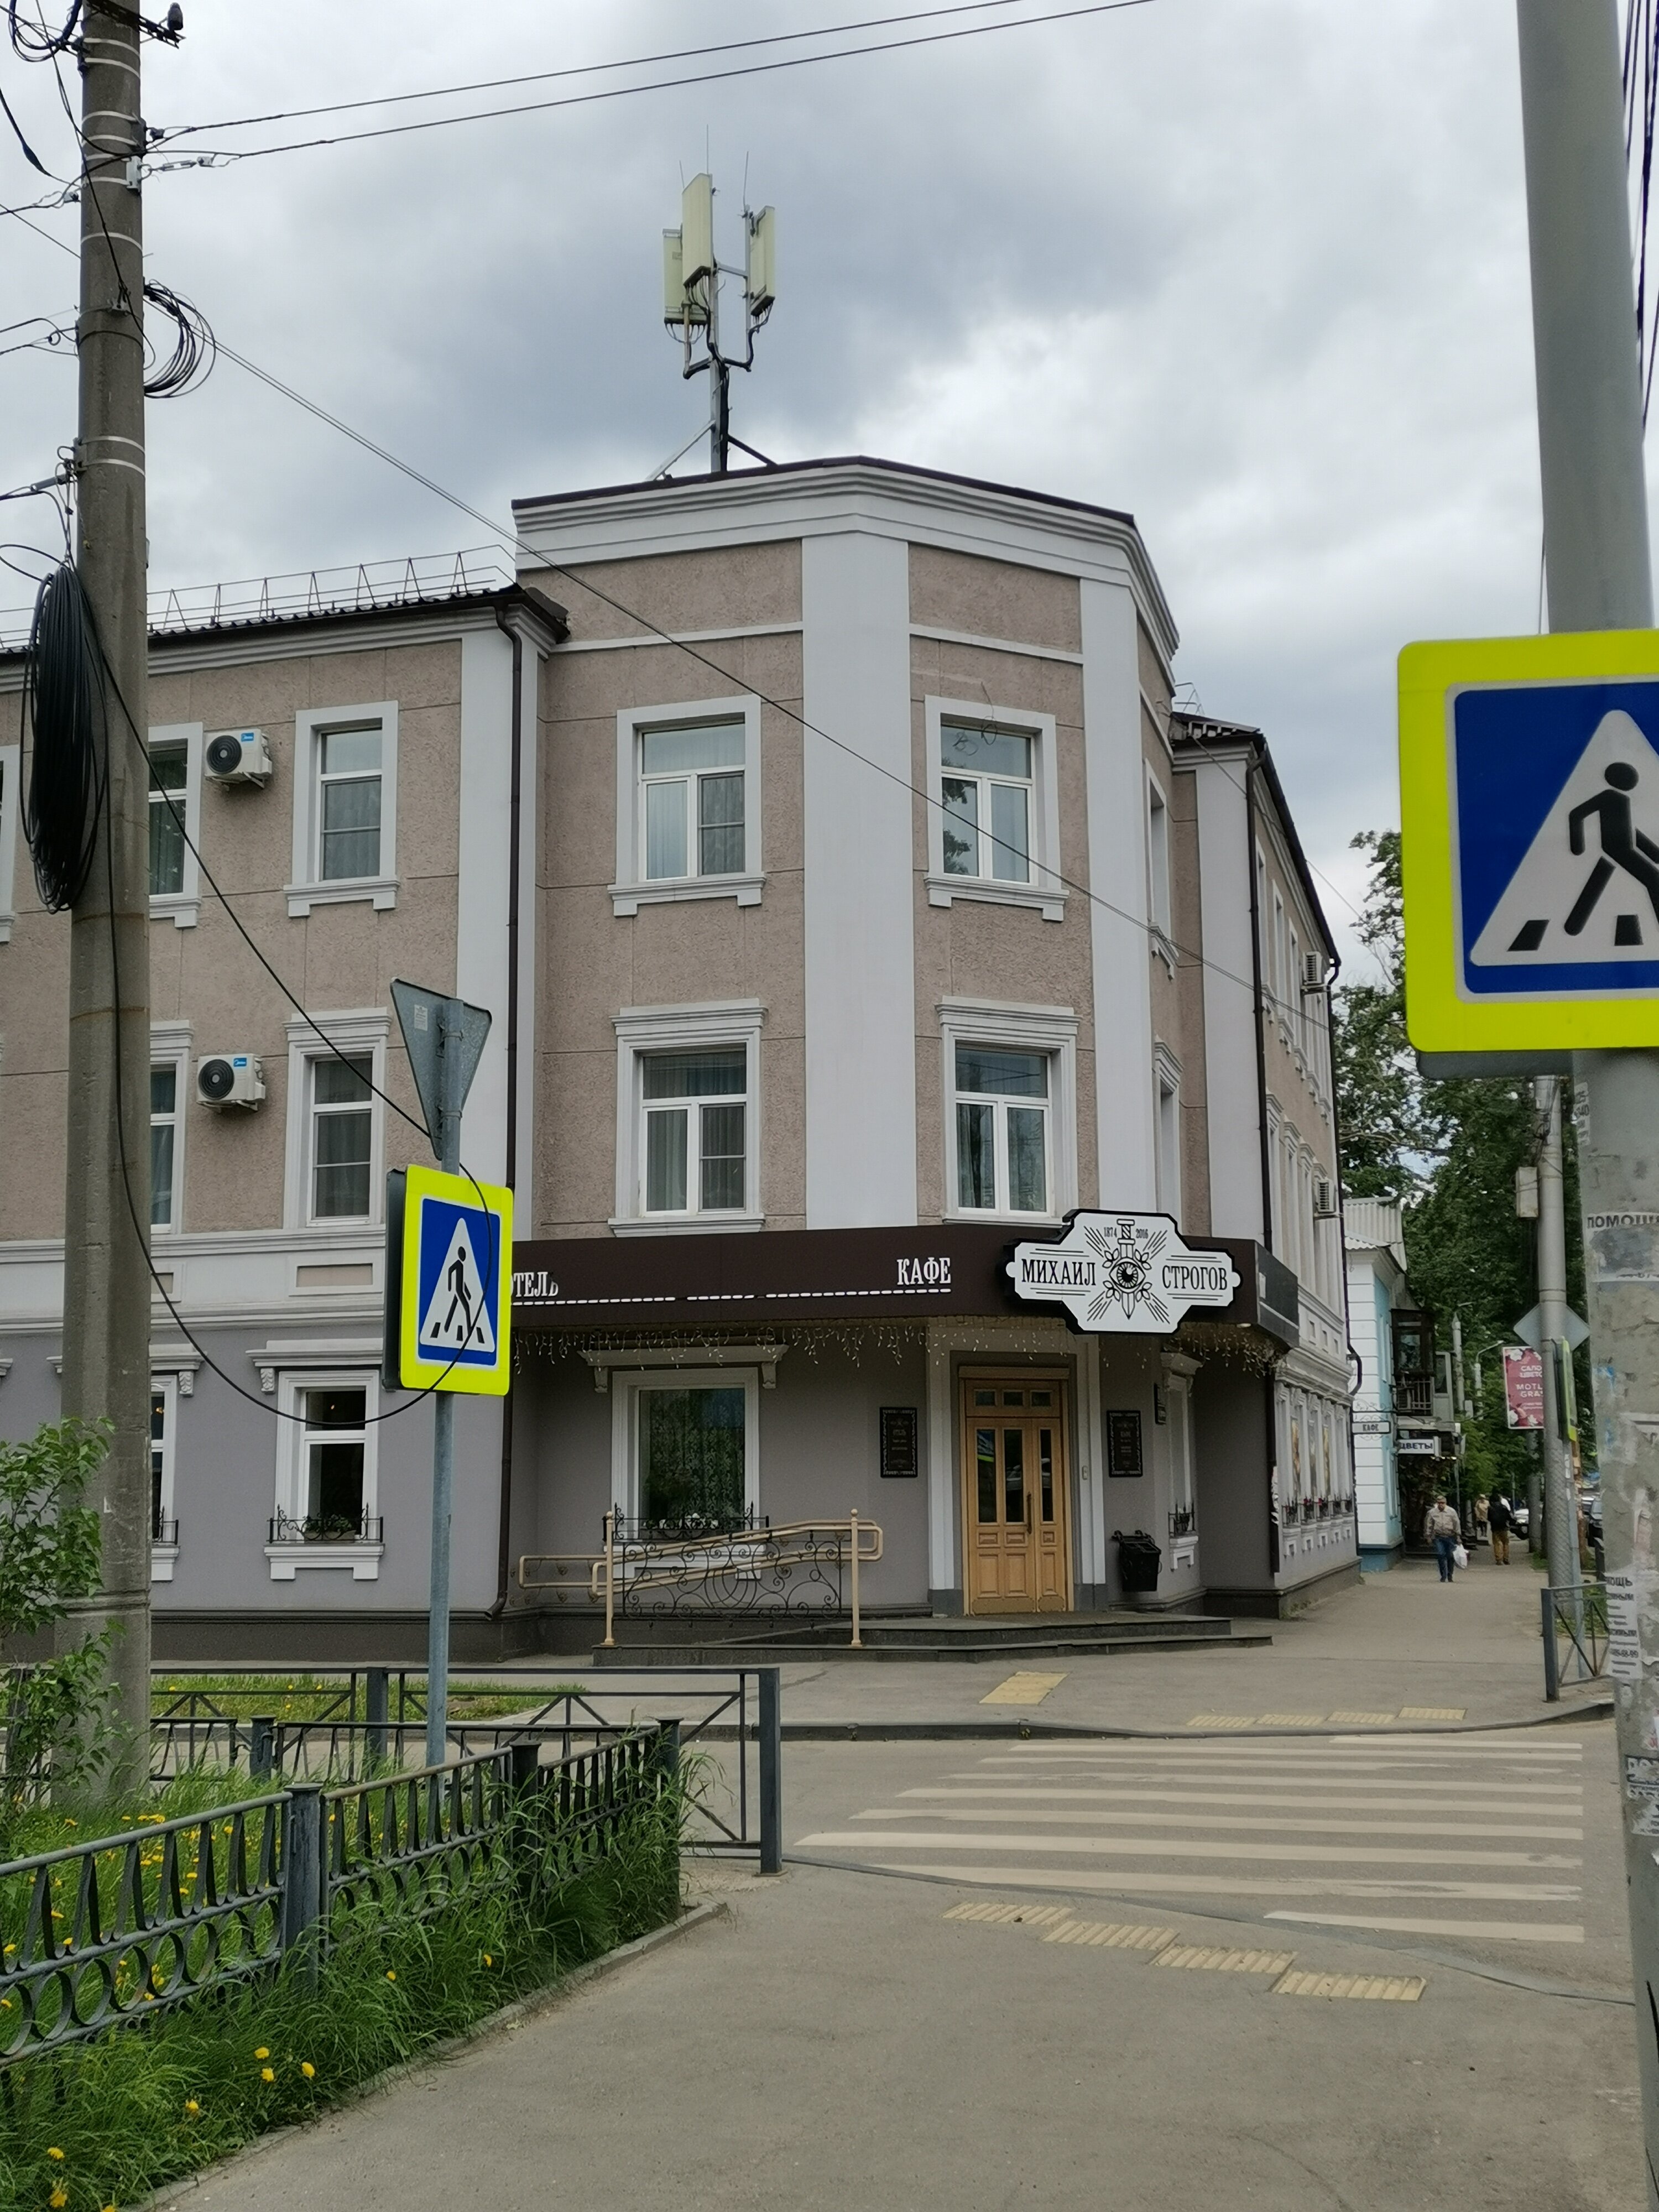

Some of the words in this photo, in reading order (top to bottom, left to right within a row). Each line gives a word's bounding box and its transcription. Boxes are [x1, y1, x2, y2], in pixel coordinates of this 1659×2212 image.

[511, 1271, 559, 1297] ТЕЛЬ
[896, 1257, 951, 1285] КАФЕ
[1021, 1259, 1097, 1286] МИХАИЛ
[1162, 1265, 1228, 1291] СТРОГОВ
